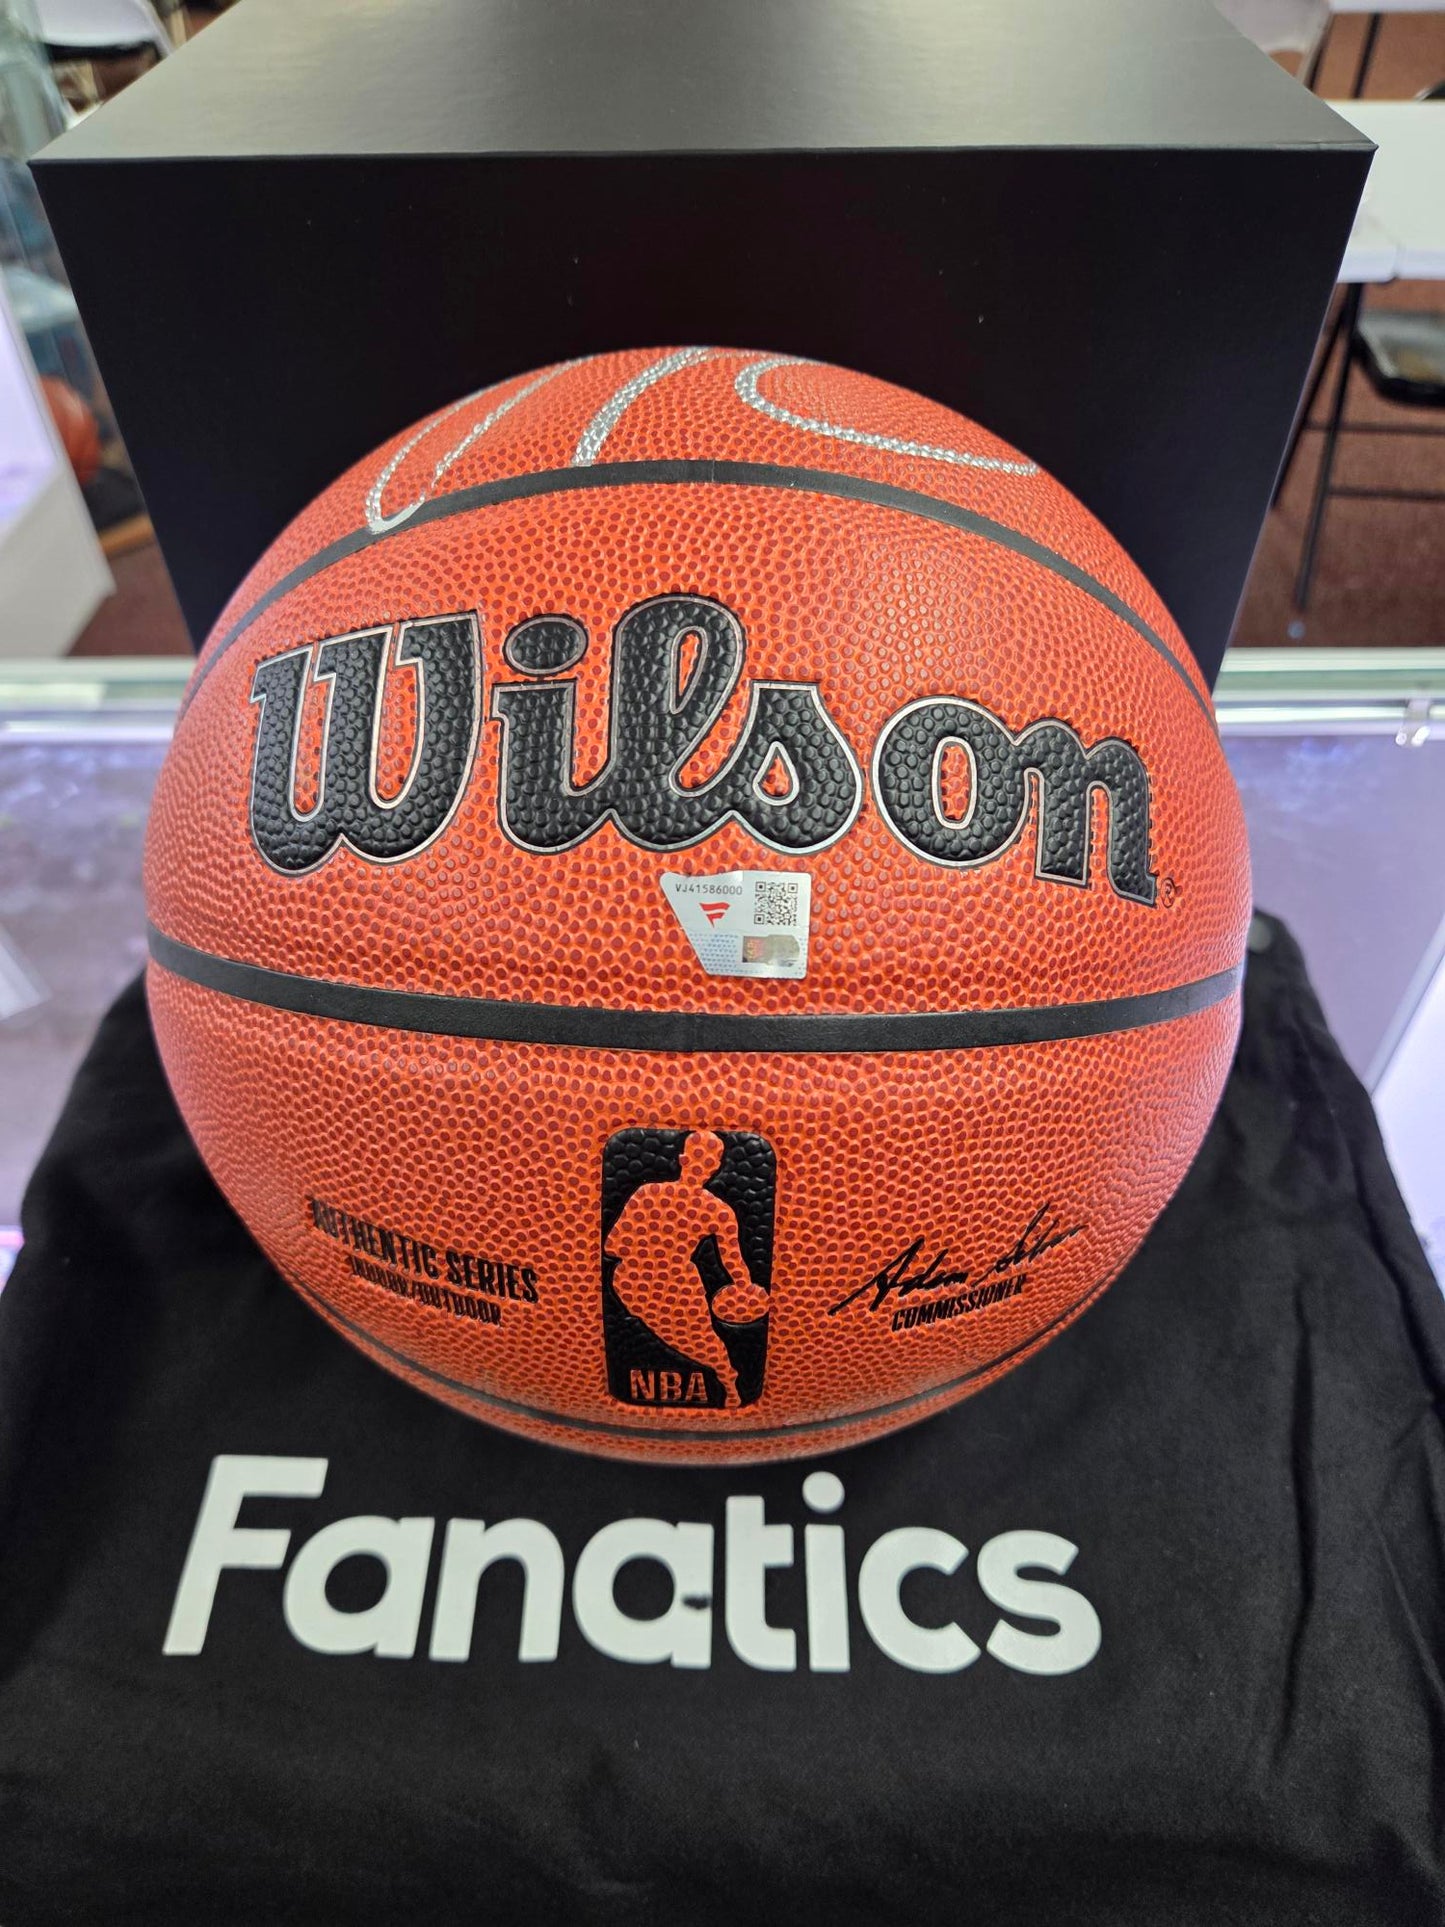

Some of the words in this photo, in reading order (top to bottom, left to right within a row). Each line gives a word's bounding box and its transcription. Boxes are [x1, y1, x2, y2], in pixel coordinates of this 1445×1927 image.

[249, 592, 1157, 909] Wilson
[675, 883, 743, 896] VJ41586000
[311, 1196, 440, 1280] AUTHENTIC
[445, 1250, 540, 1304] SERIES
[891, 1273, 1028, 1333] COMMISSIONER
[629, 1368, 709, 1404] NBA
[162, 1454, 1103, 1676] Fanatics
